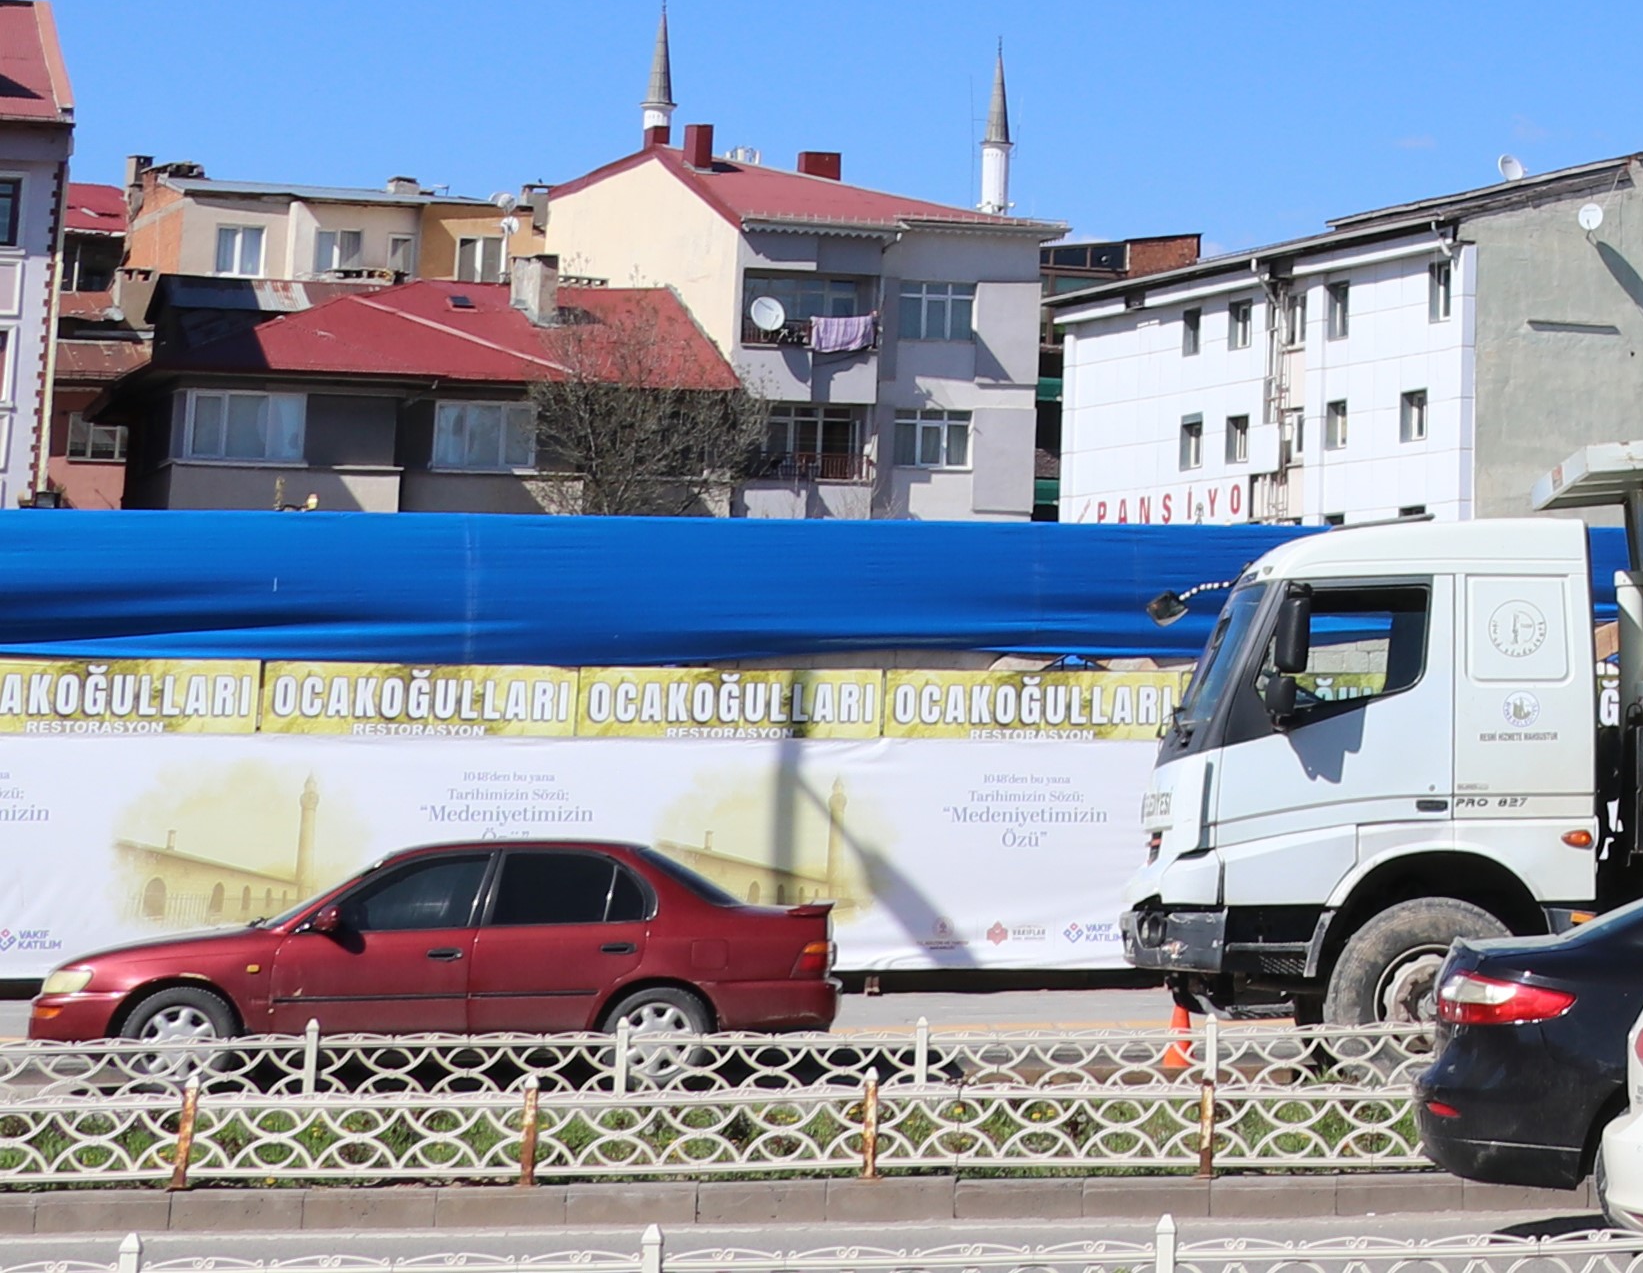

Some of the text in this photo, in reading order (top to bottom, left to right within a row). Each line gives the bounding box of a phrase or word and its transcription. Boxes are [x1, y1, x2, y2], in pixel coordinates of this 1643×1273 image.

[274, 669, 569, 721] OCAKOĞULLARI
[588, 673, 874, 723] OCAKOĞULLARI
[894, 676, 1174, 725] OCAKOĞULLARI
[26, 720, 164, 734] RESTORASYON
[352, 723, 486, 736] RESTORASYON
[666, 726, 794, 739] RESTORASYON
[969, 728, 1094, 741] RESTORASYON
[1045, 776, 1072, 787] yana
[448, 788, 529, 802] Tarihimizin
[968, 790, 1046, 803] Tarihimizin
[1455, 796, 1529, 808] PRO 827
[19, 929, 51, 940] VAKIF
[1085, 923, 1114, 933] VAKIF
[18, 940, 63, 950] KATILIM
